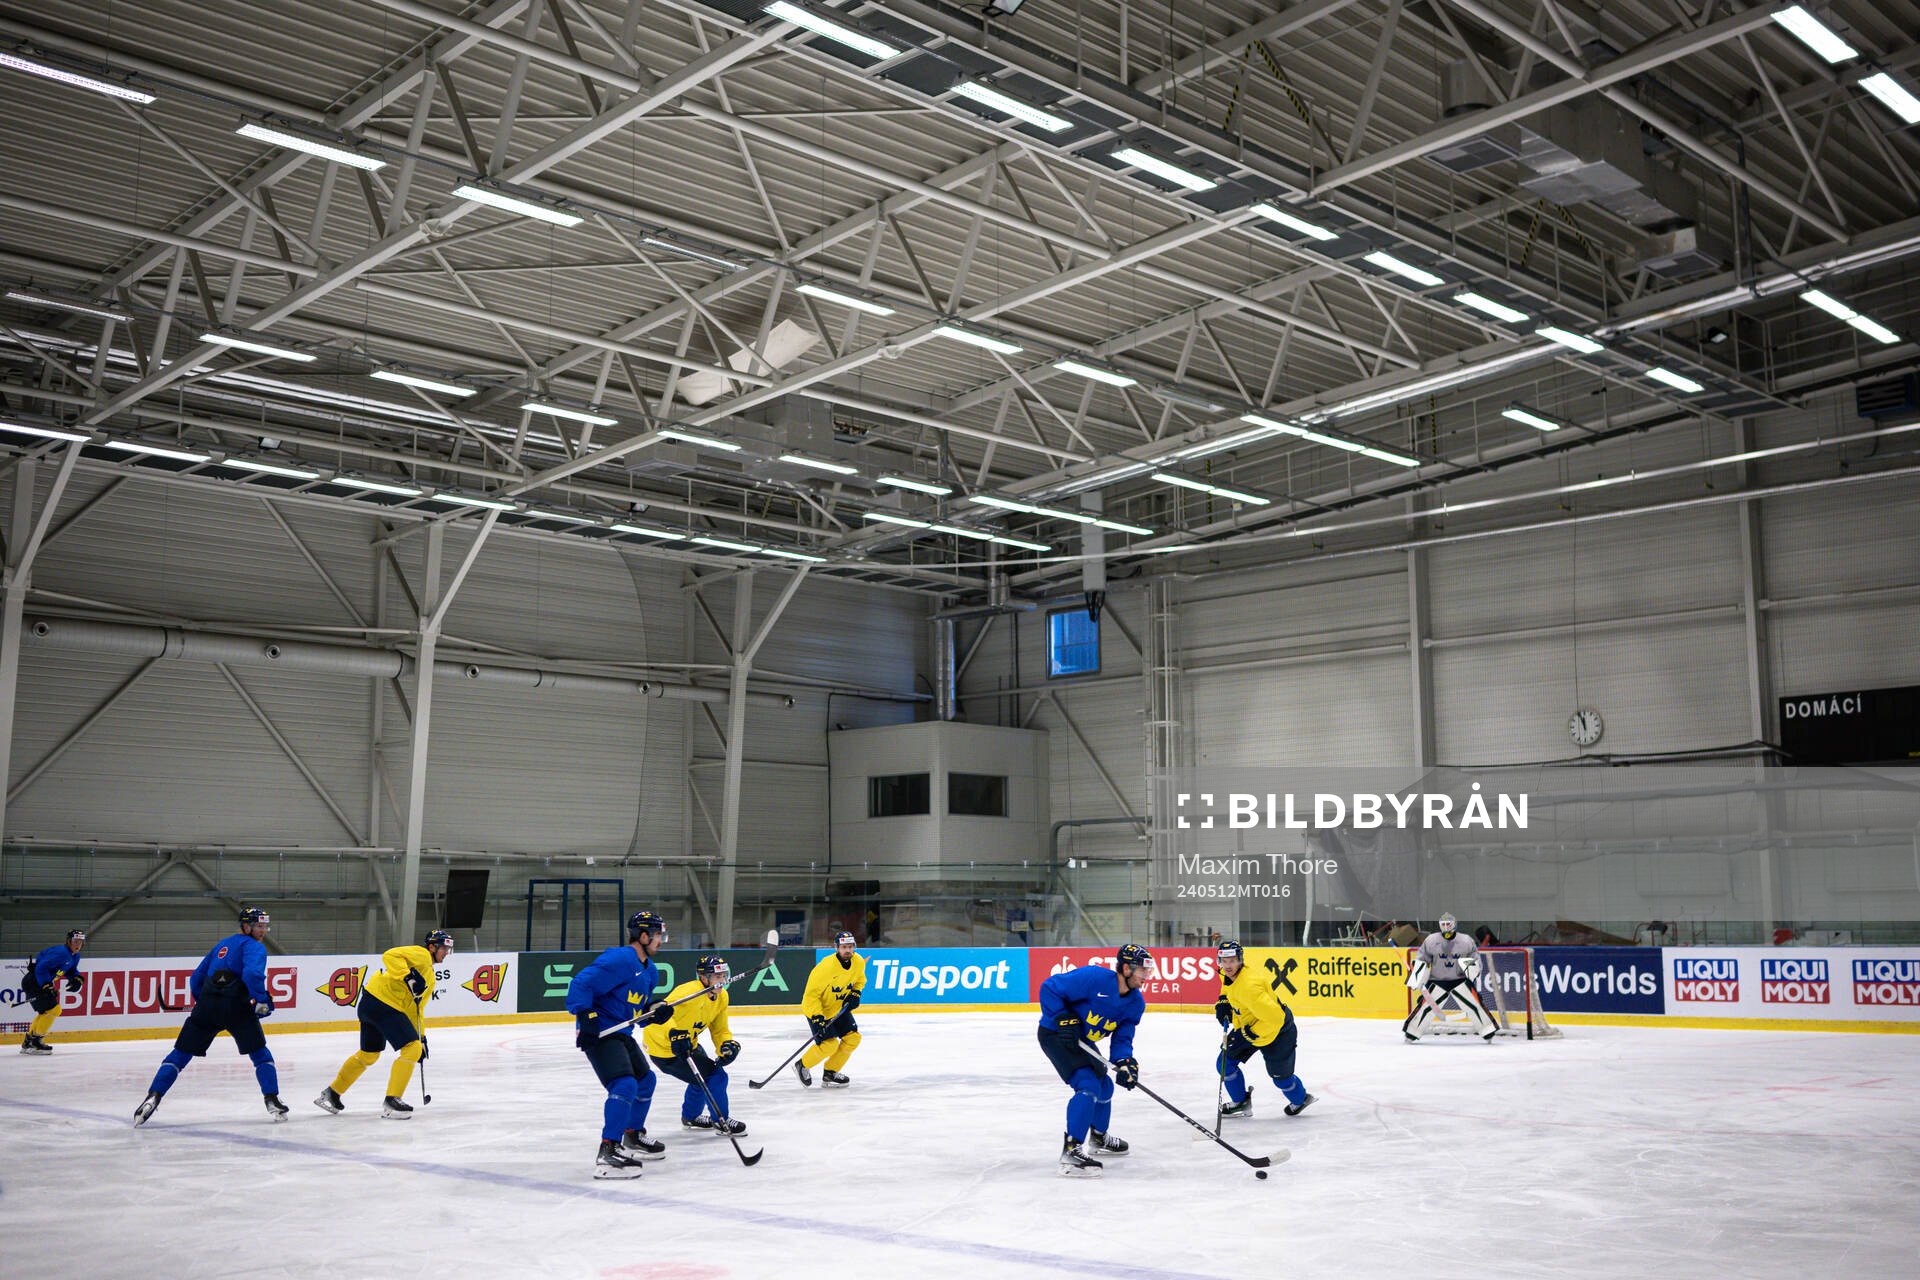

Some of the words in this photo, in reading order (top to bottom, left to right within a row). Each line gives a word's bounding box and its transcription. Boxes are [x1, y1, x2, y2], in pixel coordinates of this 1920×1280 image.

[1785, 692, 1862, 719] DOMÁCÍ
[1308, 956, 1402, 976] Raiffeisen
[1676, 960, 1736, 980] LIQUI
[1763, 960, 1826, 981] LIQUI
[1855, 960, 1920, 982] LIQUI
[872, 959, 1010, 996] Tipsport
[1475, 964, 1657, 995] ensWorlds
[59, 973, 294, 1009] BAUHS
[1308, 980, 1355, 998] Bank
[1677, 981, 1737, 1001] MOLY
[1764, 982, 1829, 1002] MOLY
[1856, 983, 1920, 1004] MOLY
